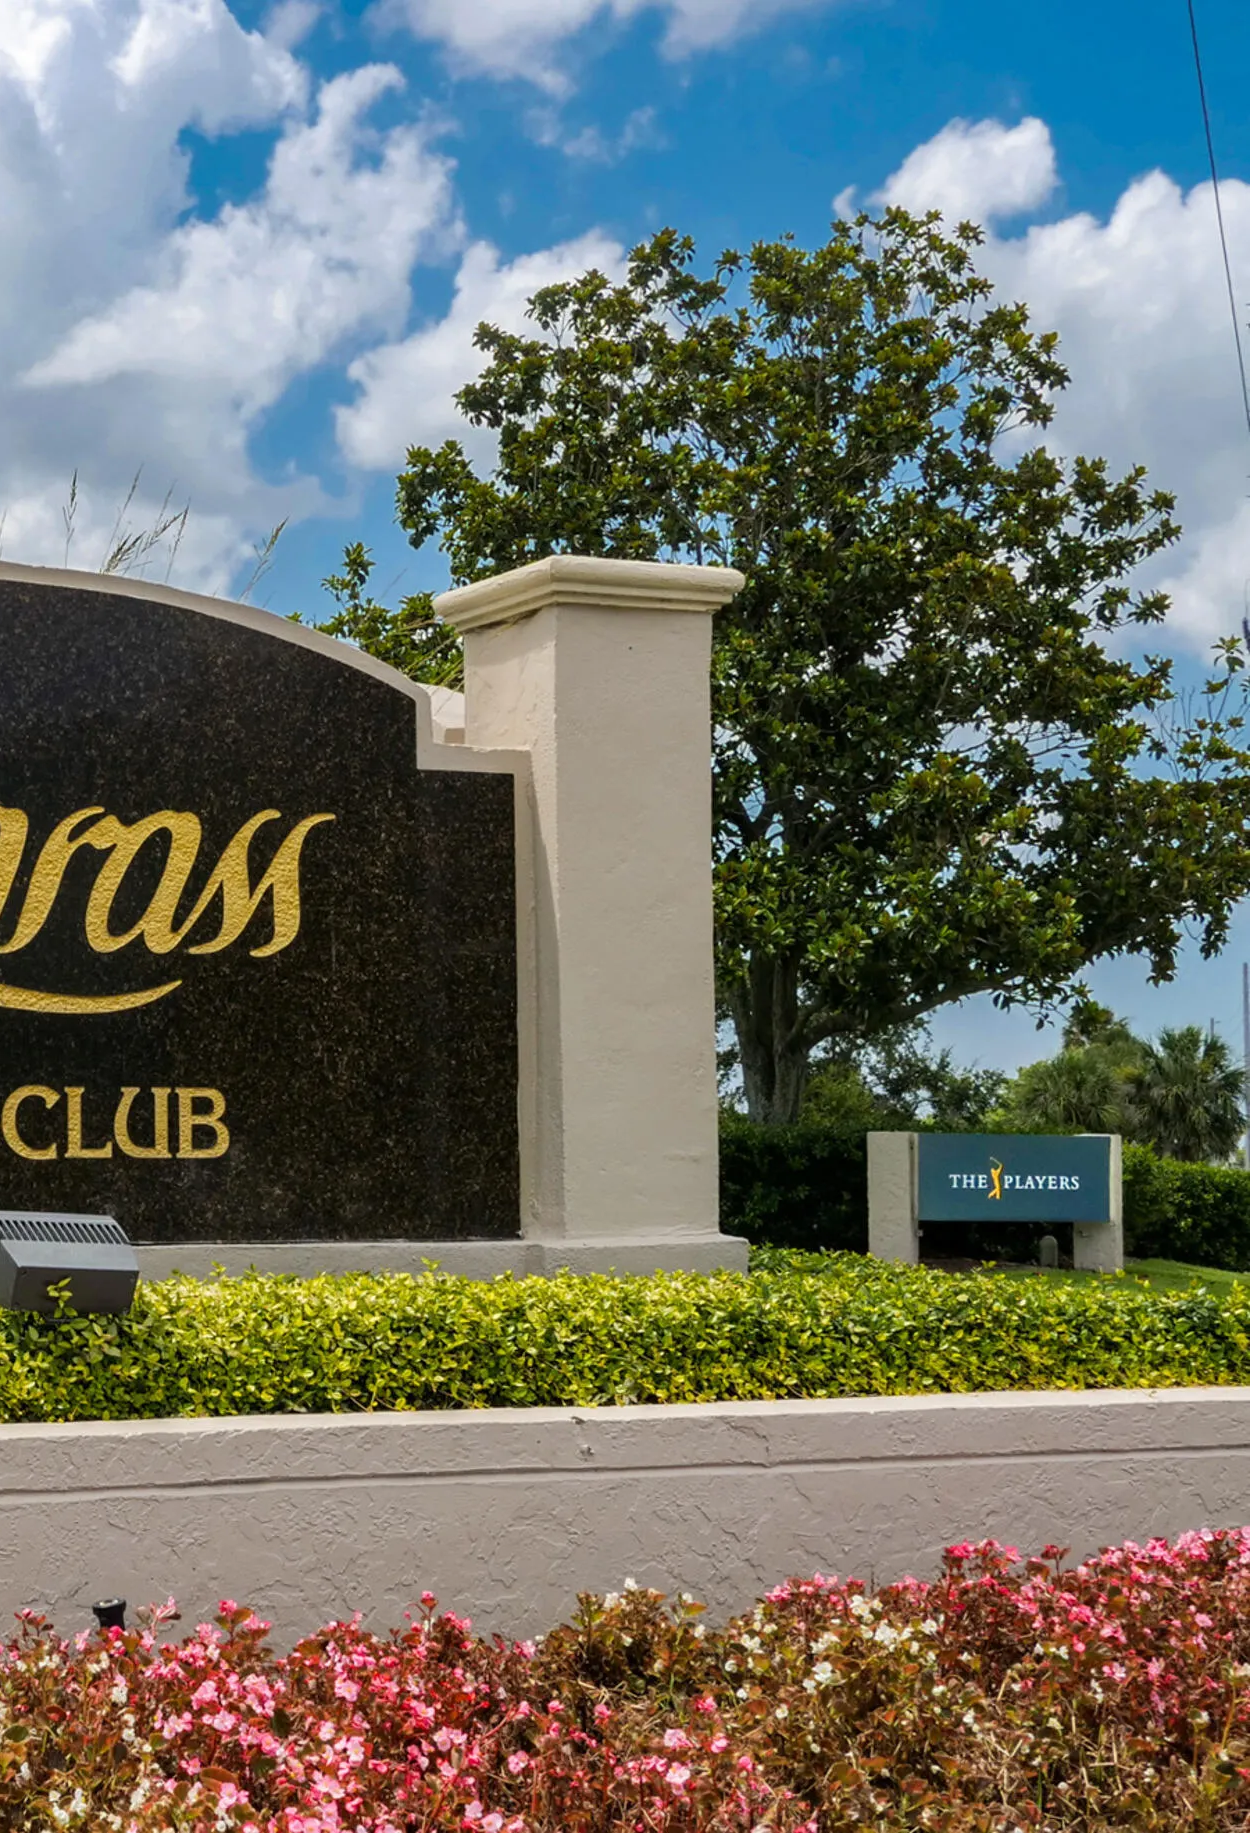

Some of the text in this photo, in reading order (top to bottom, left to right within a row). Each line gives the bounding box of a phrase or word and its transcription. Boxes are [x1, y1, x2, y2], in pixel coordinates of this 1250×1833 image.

[1, 1085, 231, 1160] CLUB
[949, 1174, 1080, 1191] THE PLAYERS
